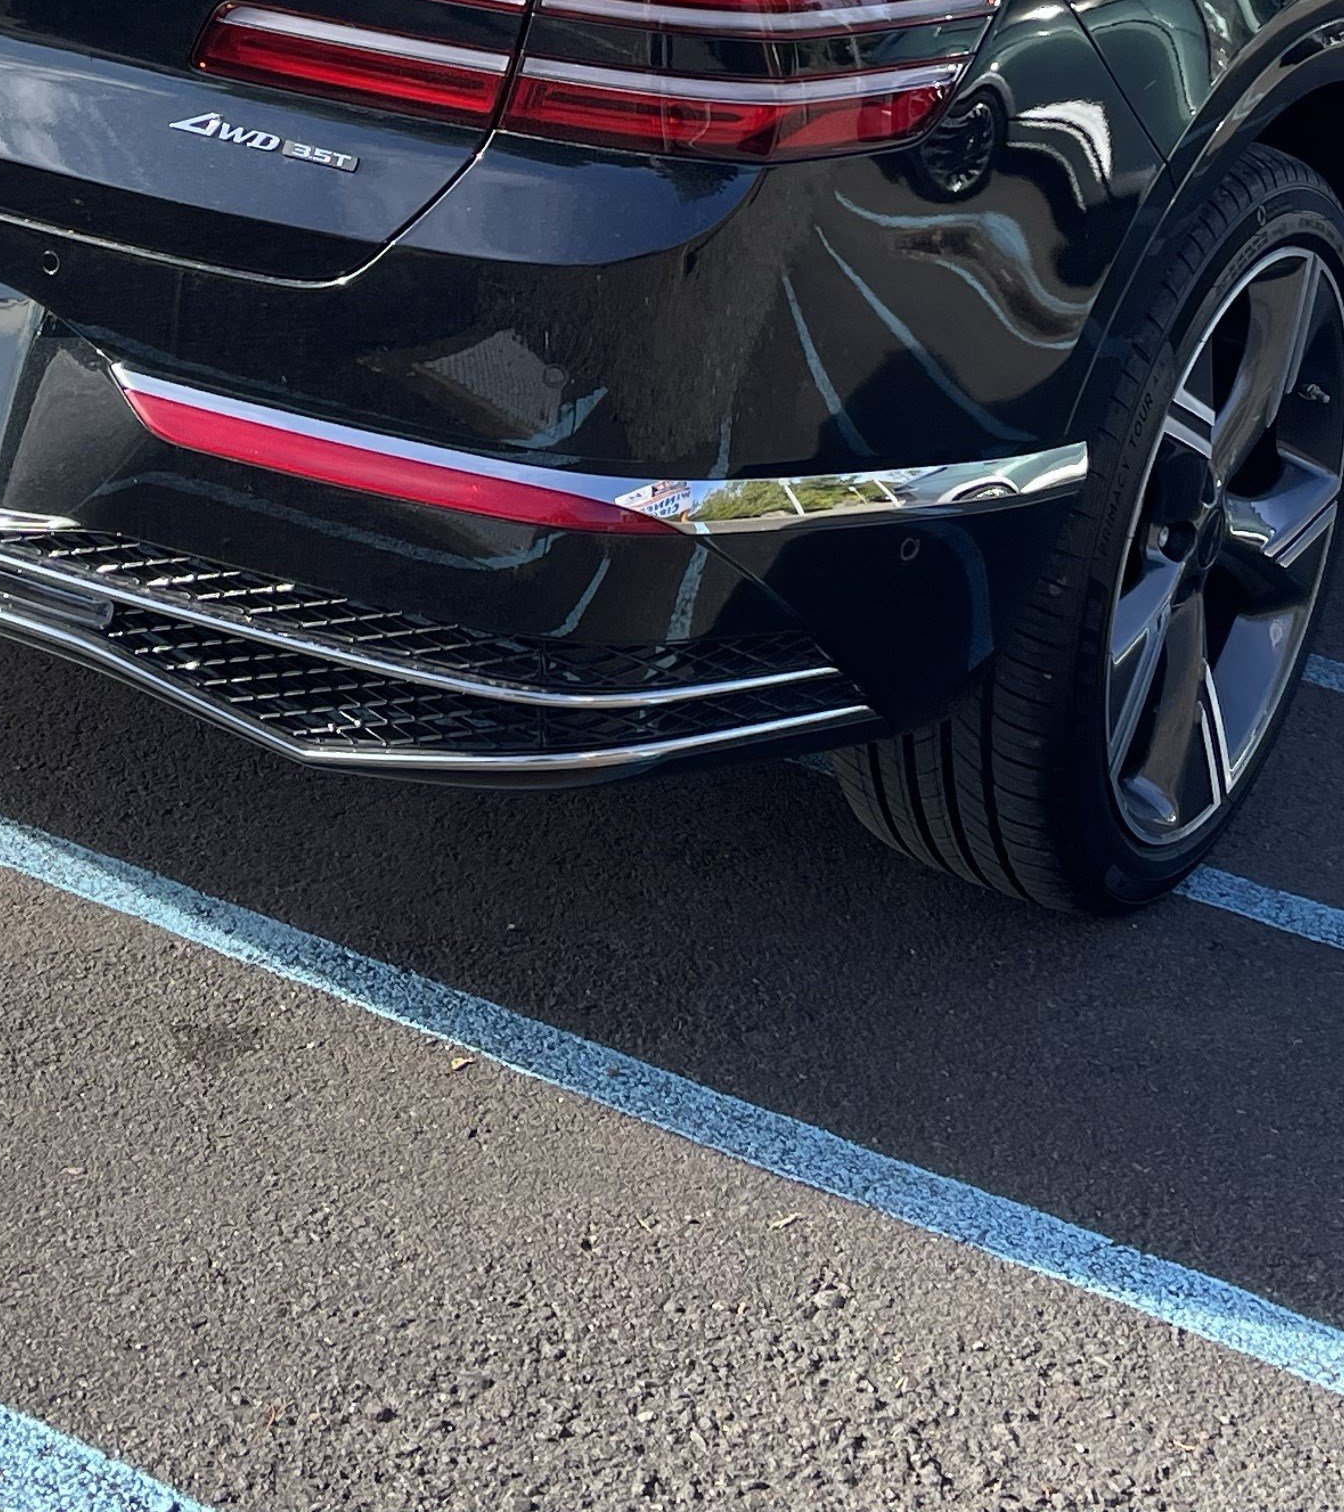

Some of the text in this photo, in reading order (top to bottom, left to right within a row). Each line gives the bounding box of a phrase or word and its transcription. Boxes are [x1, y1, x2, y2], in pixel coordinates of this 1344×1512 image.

[169, 112, 282, 151] AWD
[1098, 391, 1154, 557] PRIMACY TOUR
